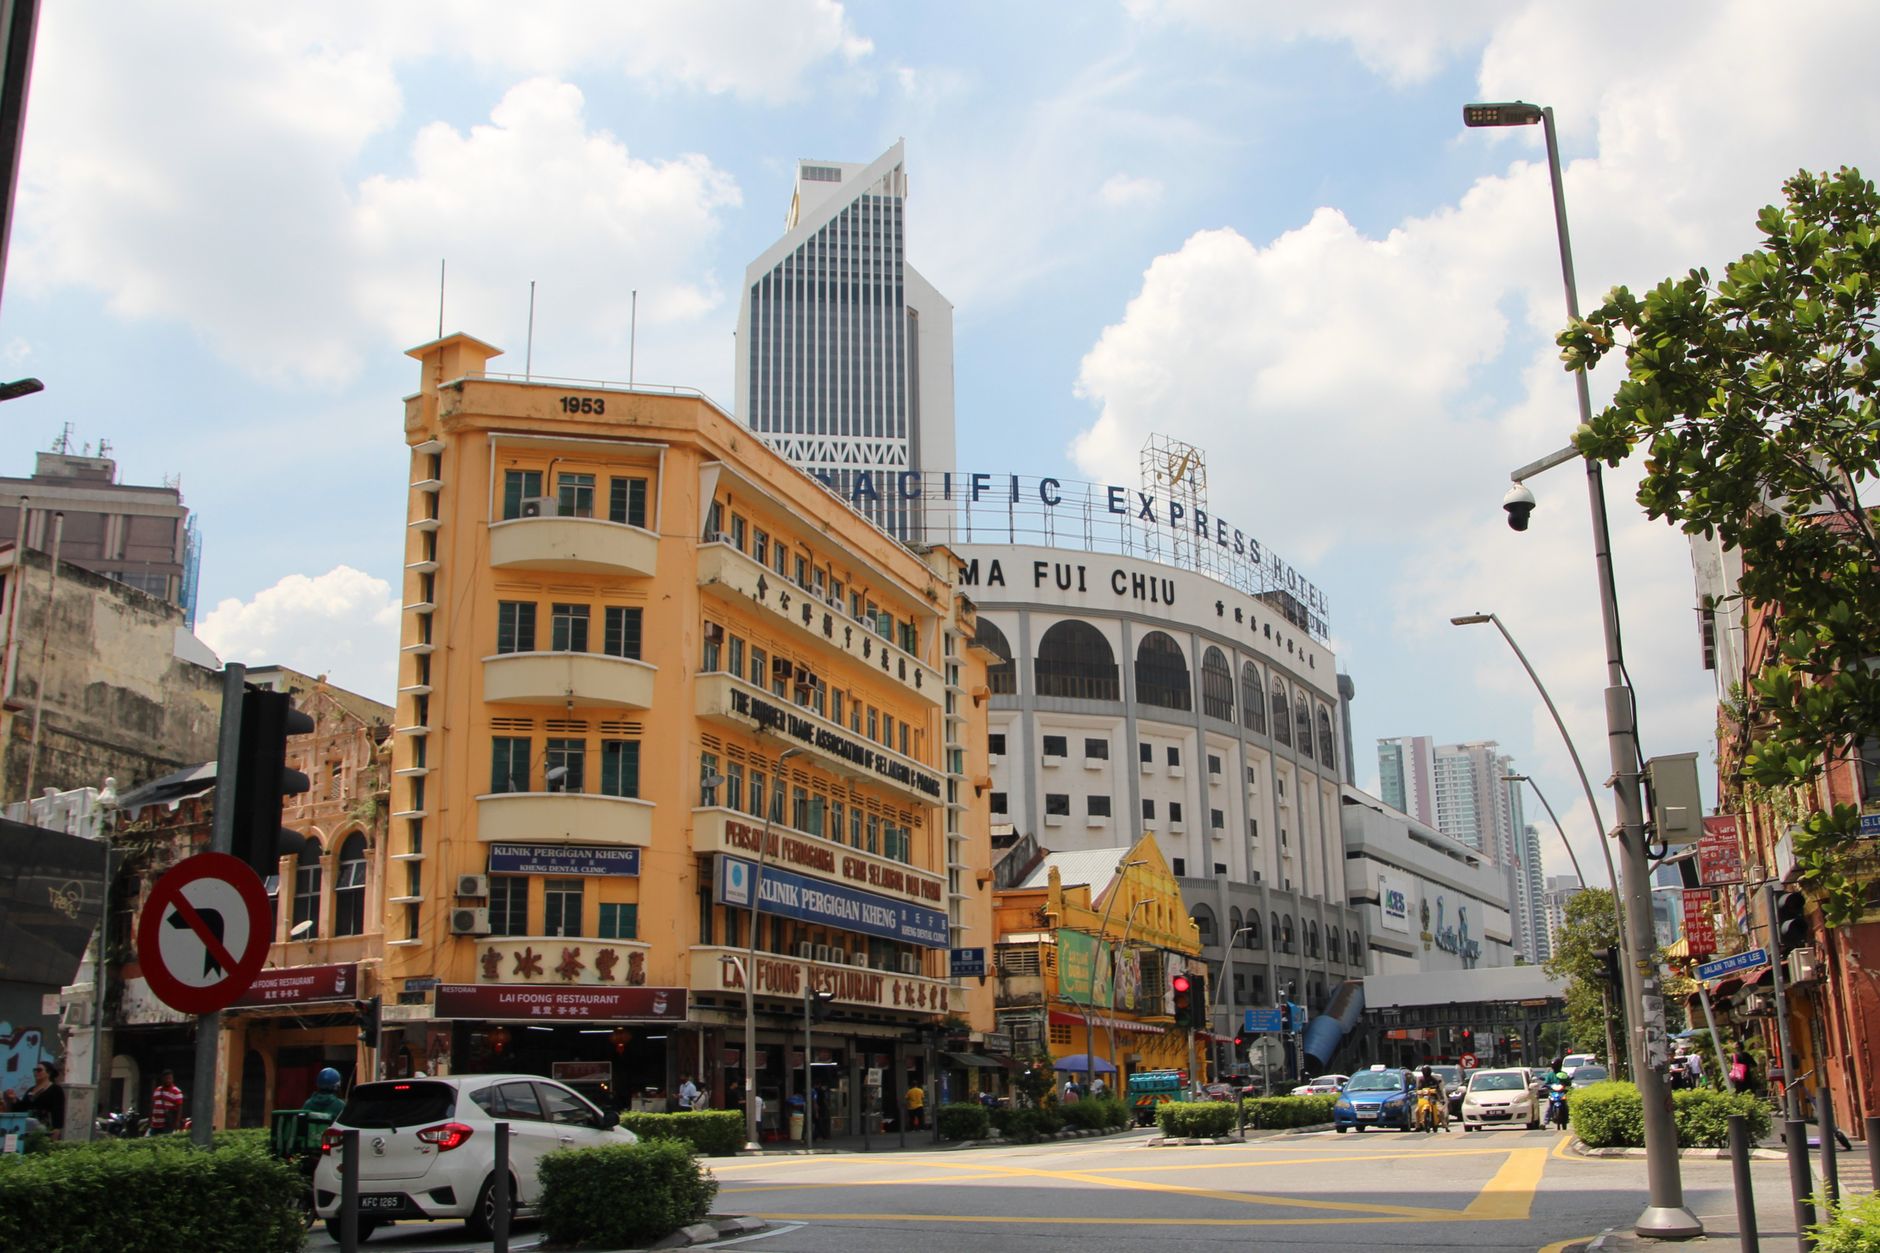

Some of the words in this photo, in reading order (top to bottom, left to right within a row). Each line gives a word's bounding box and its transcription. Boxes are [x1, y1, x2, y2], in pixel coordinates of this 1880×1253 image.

[560, 396, 606, 416] 1953
[1108, 486, 1261, 564] EXPRESS
[1274, 554, 1327, 615] HOTEL
[1033, 561, 1087, 592] FUI
[1111, 569, 1175, 605] CHIU
[730, 687, 750, 717] THE
[787, 713, 815, 744] TRADE
[815, 727, 864, 766] ASSOCIATION
[865, 749, 874, 769] OF
[875, 753, 910, 785] SELANGOR
[493, 847, 531, 857] KLINIK
[534, 848, 592, 859] PERGIGIAN
[595, 850, 633, 860] KHENG
[581, 866, 607, 874] CLINIC
[842, 855, 867, 882] GETAH
[905, 873, 920, 897] DAN
[758, 878, 799, 907] KLINIK
[801, 888, 860, 921] PERGIGIAN
[862, 903, 896, 929] KHENG
[1703, 962, 1723, 975] JALAN
[1722, 959, 1737, 969] TUN
[1737, 956, 1747, 965] HS
[1748, 952, 1761, 962] LEE
[258, 978, 278, 988] FOONG
[279, 976, 316, 987] RESTAURANT
[756, 959, 801, 994] FOONG
[807, 966, 884, 1003] RESTAURANT
[500, 994, 516, 1003] LAI
[517, 994, 553, 1004] FOONG
[556, 994, 620, 1005] RESTAURANT
[362, 1196, 378, 1207] KFC
